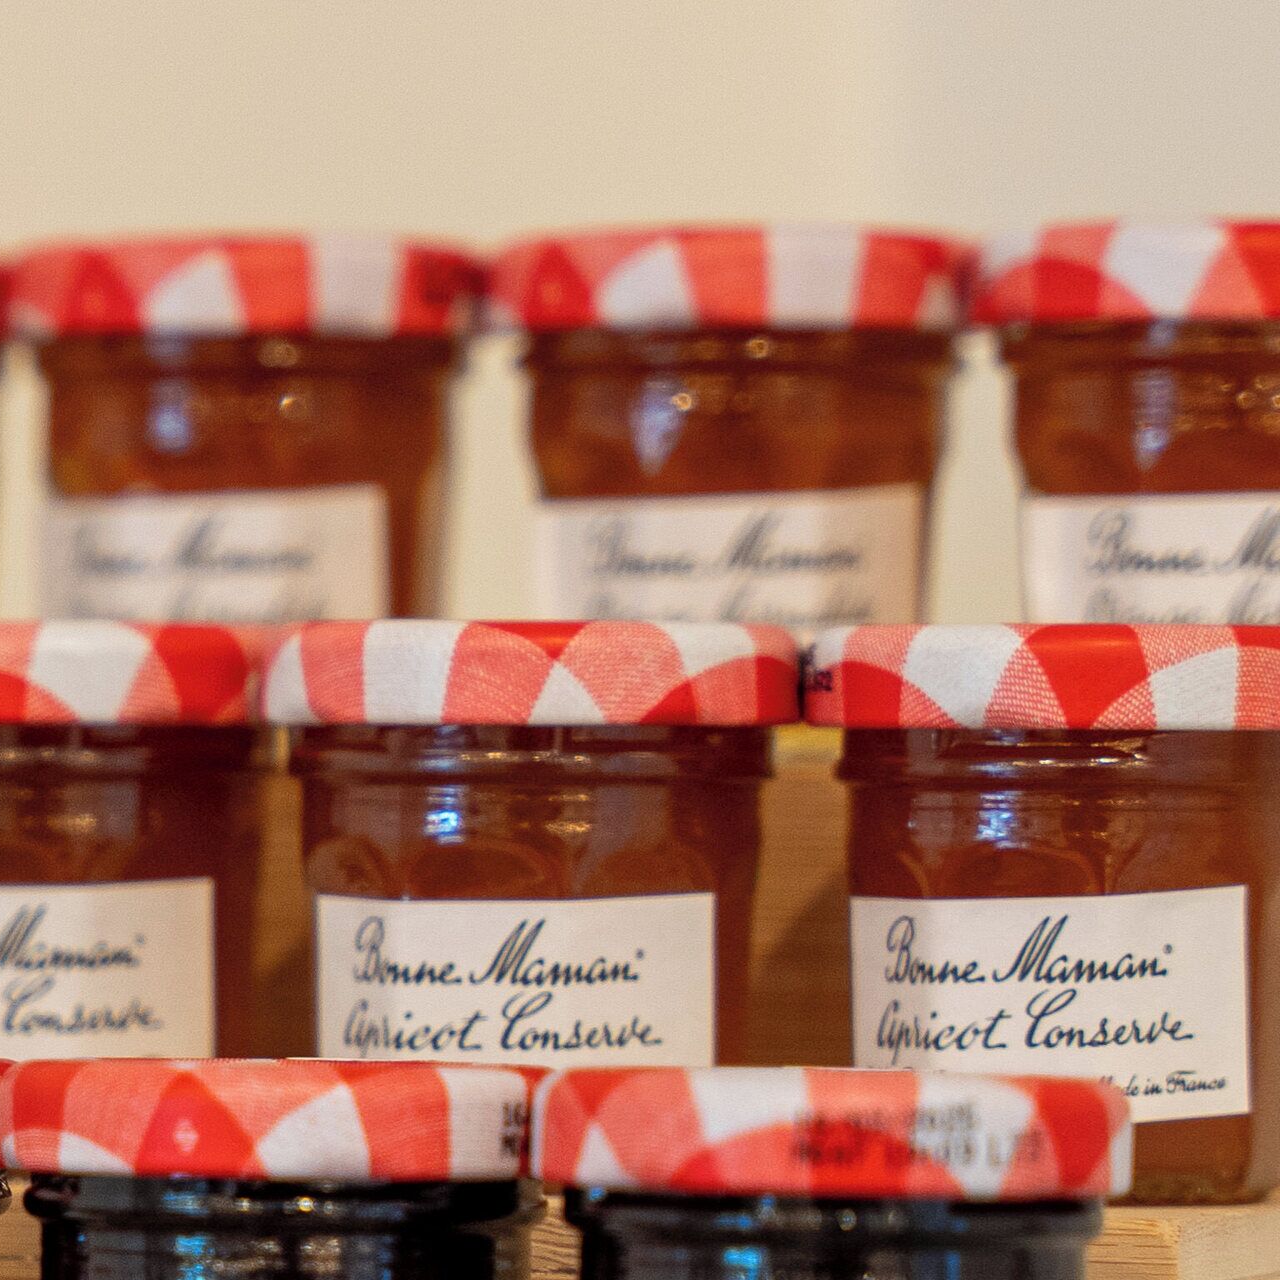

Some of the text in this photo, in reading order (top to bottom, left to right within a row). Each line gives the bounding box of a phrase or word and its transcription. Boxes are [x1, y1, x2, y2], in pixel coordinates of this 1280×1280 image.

[886, 915, 986, 983] Bonne
[501, 991, 663, 1050] Conserve
[877, 988, 1193, 1064] Apricot Conserve
